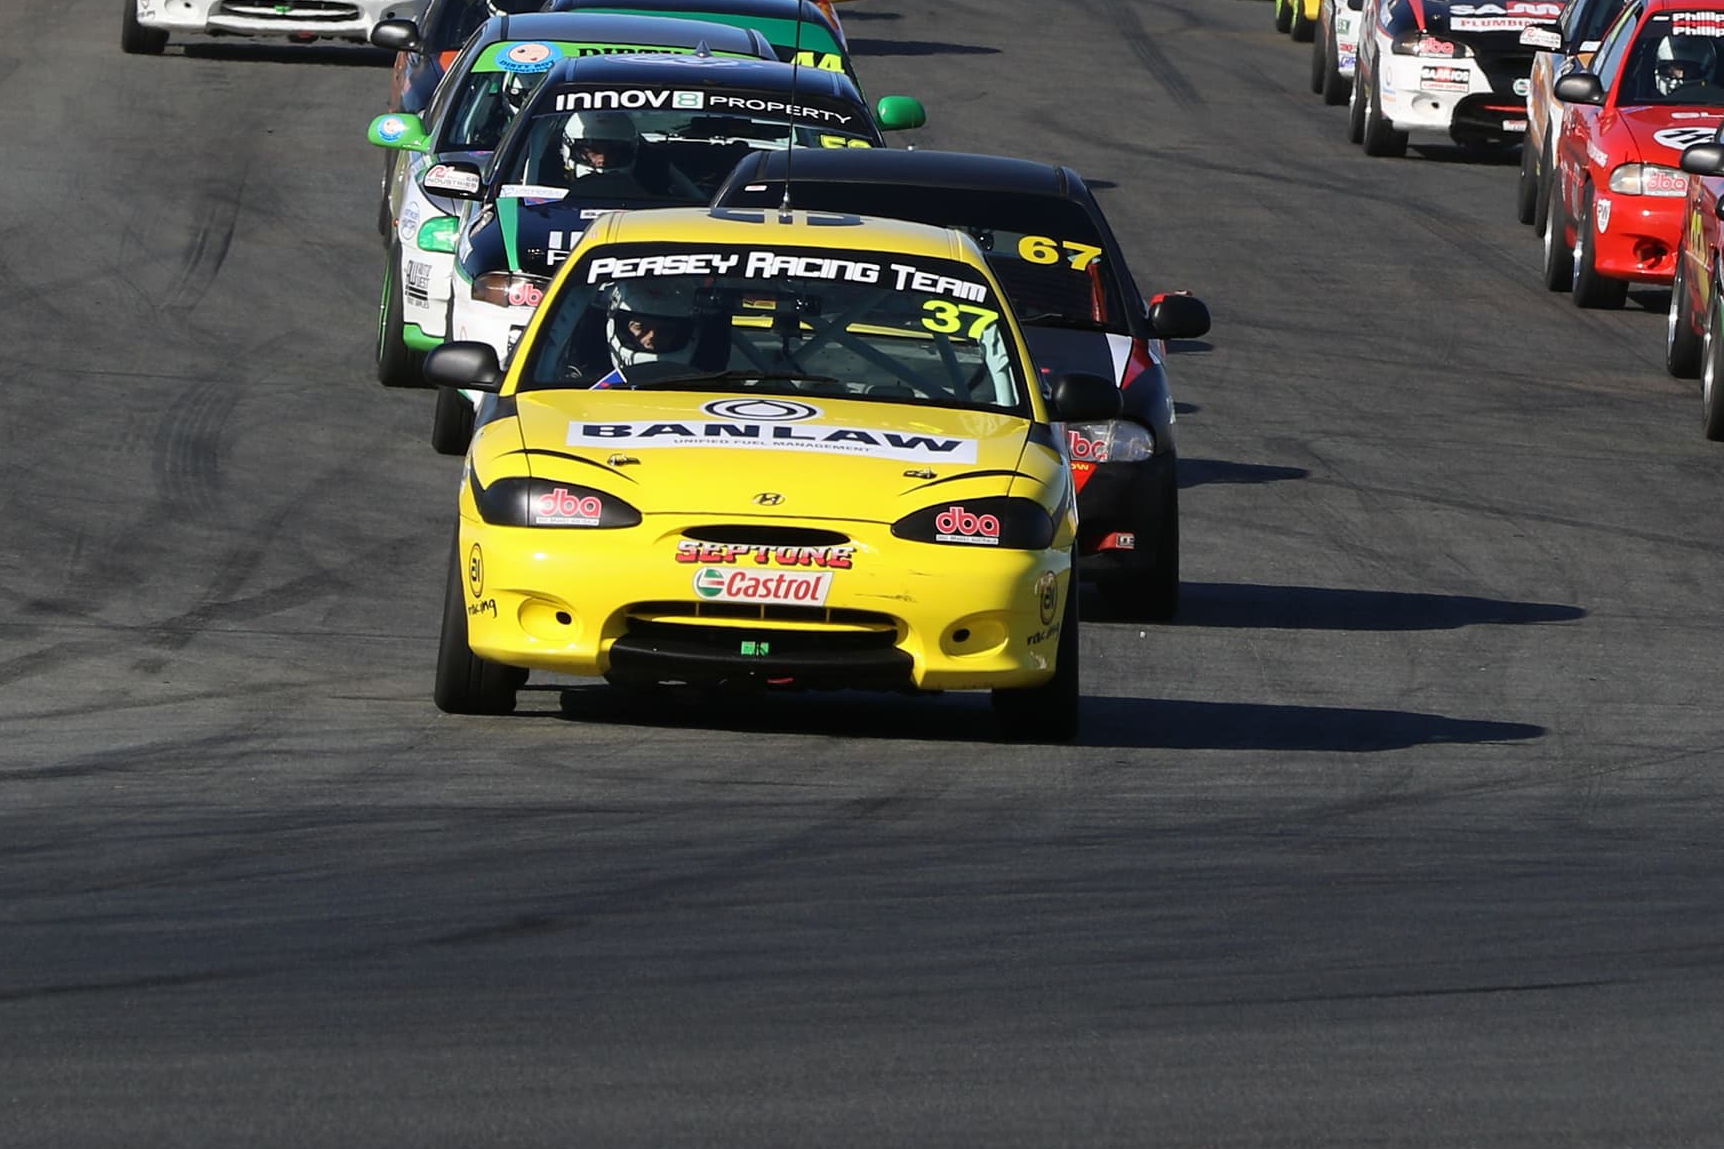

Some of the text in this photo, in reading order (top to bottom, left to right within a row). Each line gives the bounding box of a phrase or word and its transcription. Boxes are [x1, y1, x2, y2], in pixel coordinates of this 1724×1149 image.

[1450, 3, 1561, 16] SAM
[1460, 19, 1530, 27] PLUMBI
[791, 52, 845, 74] 44
[709, 95, 852, 125] PROPERTY
[1647, 173, 1689, 192] dba
[1018, 235, 1102, 272] 67
[588, 250, 988, 303] PEASEY RACING TEAM
[508, 283, 545, 306] db
[922, 300, 999, 339] 37
[581, 422, 963, 453] BANLAW
[674, 438, 730, 446] UNIFIED
[773, 441, 872, 453] MANAGEMENT
[538, 487, 603, 518] dba
[935, 506, 1000, 538] dba
[675, 540, 855, 569] SEPTONE
[726, 570, 823, 601] Castrol
[468, 598, 497, 618] racing
